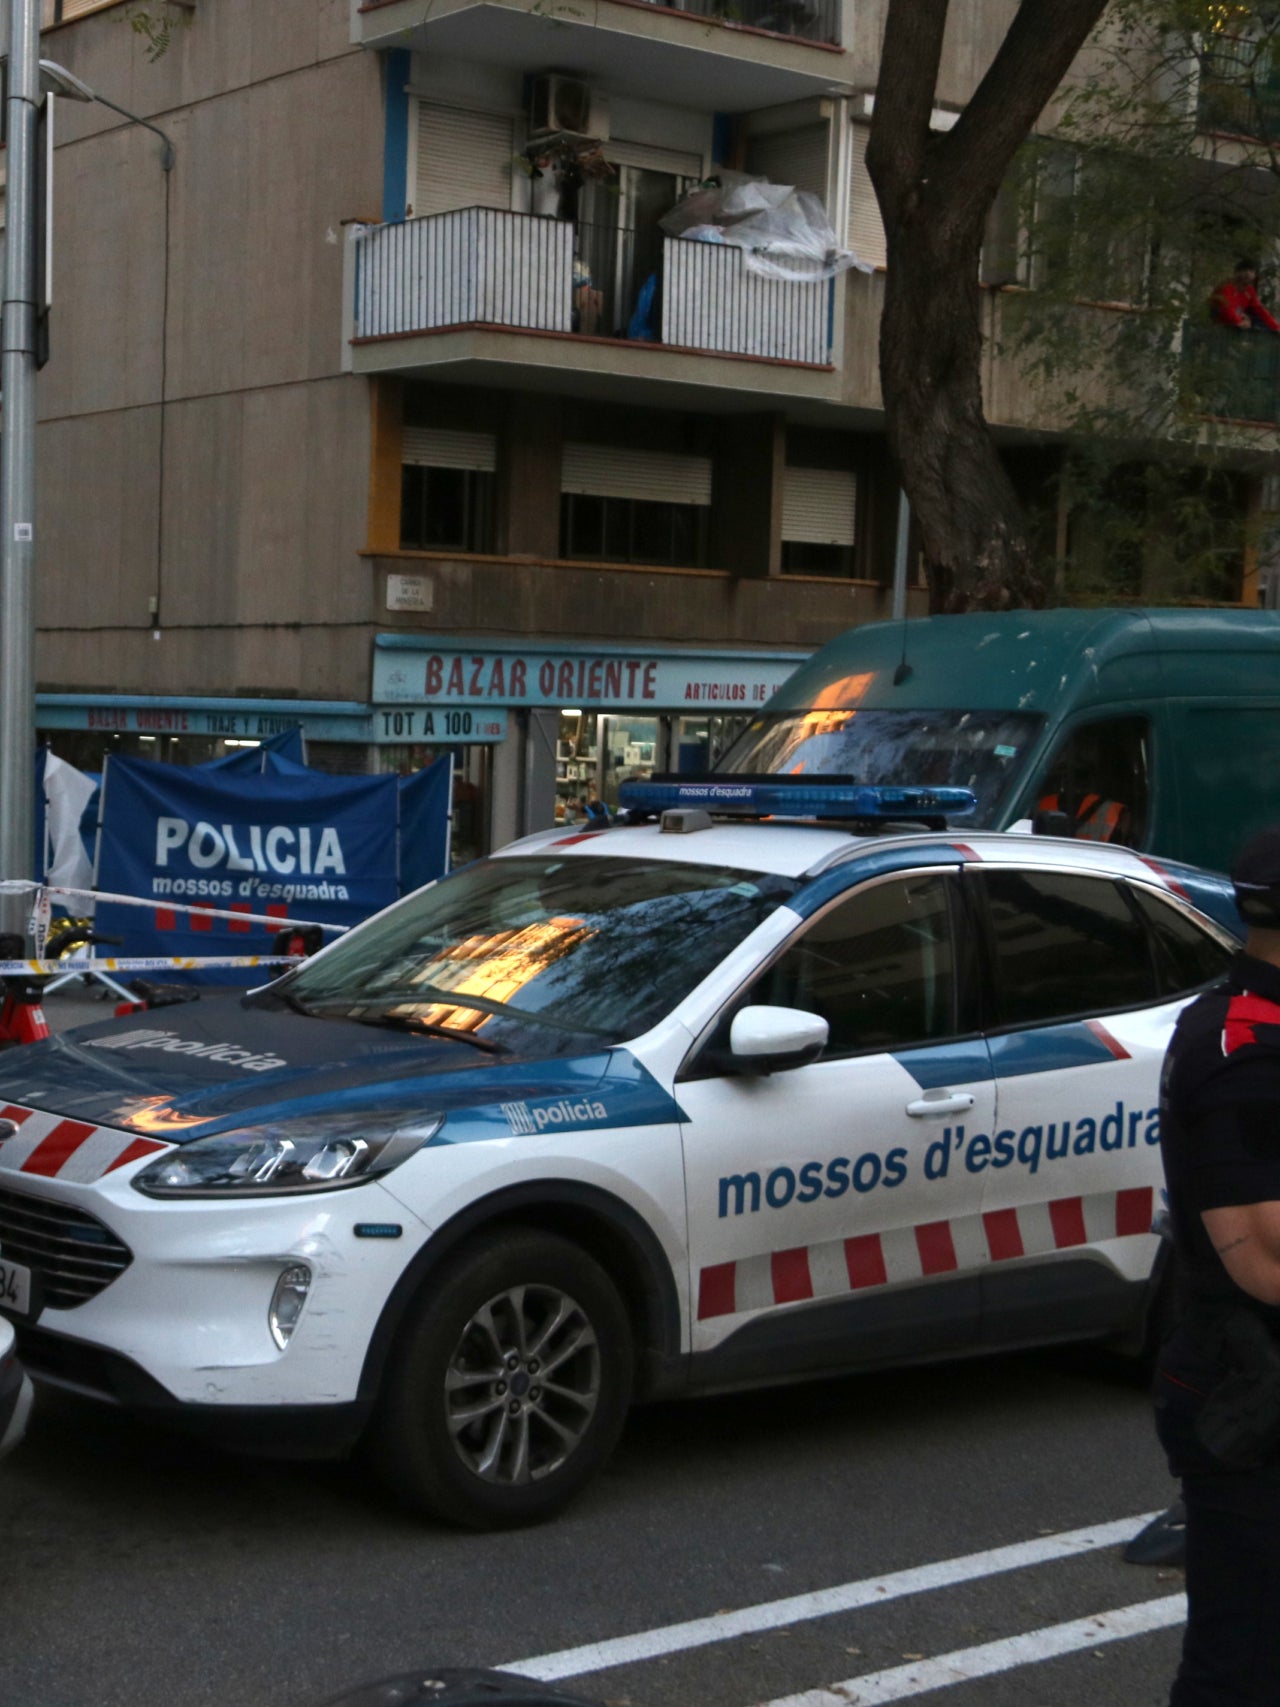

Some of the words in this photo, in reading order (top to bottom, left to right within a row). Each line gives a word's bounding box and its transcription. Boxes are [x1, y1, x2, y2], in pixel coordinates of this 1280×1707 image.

[424, 655, 528, 697] BAZAR
[538, 658, 658, 699] ORIENTE
[684, 682, 746, 701] ARTICULOS
[752, 683, 767, 701] DE
[382, 712, 415, 736] TOT
[423, 712, 435, 736] A
[444, 711, 472, 736] 100
[679, 786, 709, 797] mossos
[709, 786, 753, 798] d'esquadra
[155, 816, 347, 875] POLICIA
[152, 877, 233, 896] mossos
[238, 878, 350, 902] d'esquadra
[126, 1031, 288, 1072] policia
[532, 1098, 608, 1130] policia
[718, 1147, 908, 1218] mossos
[923, 1100, 1162, 1180] d'esquadra
